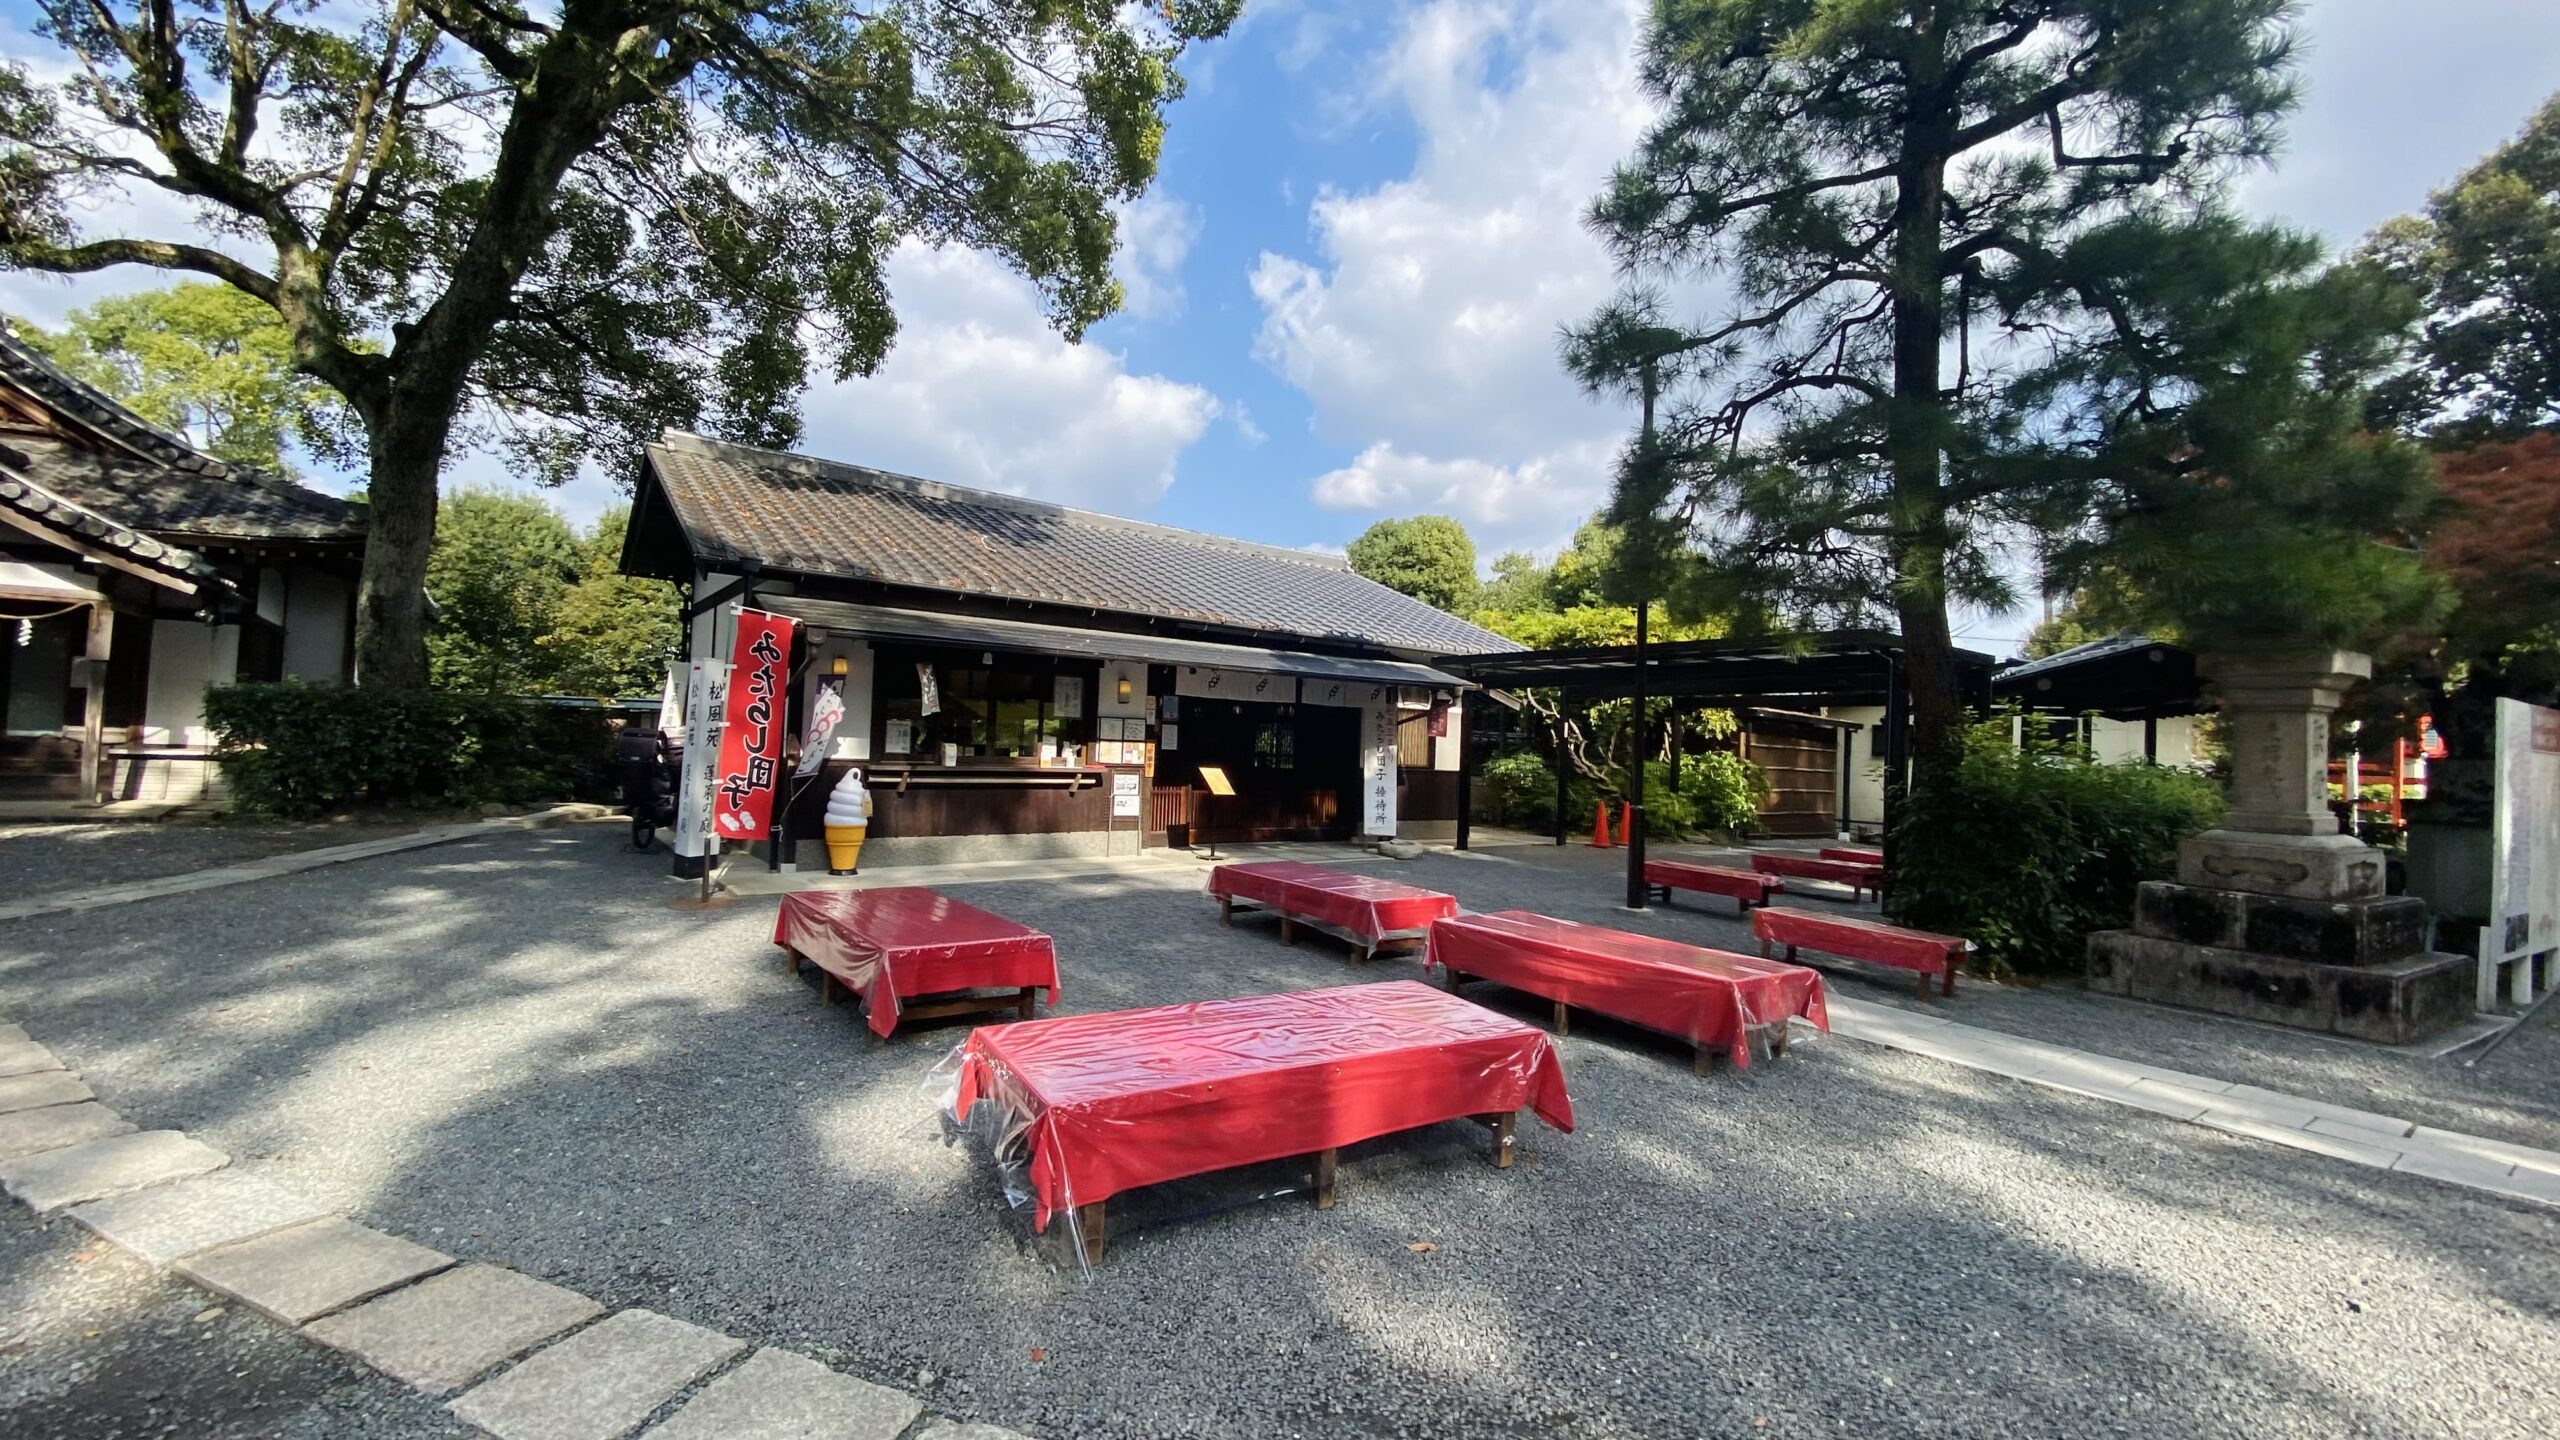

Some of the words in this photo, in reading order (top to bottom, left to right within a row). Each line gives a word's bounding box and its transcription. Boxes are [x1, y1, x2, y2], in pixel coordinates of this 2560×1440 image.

[706, 680, 723, 748] 松風苑
[720, 630, 782, 810] みたらし団子
[1376, 711, 1386, 781] みたらし団子
[1375, 785, 1387, 824] 接待所
